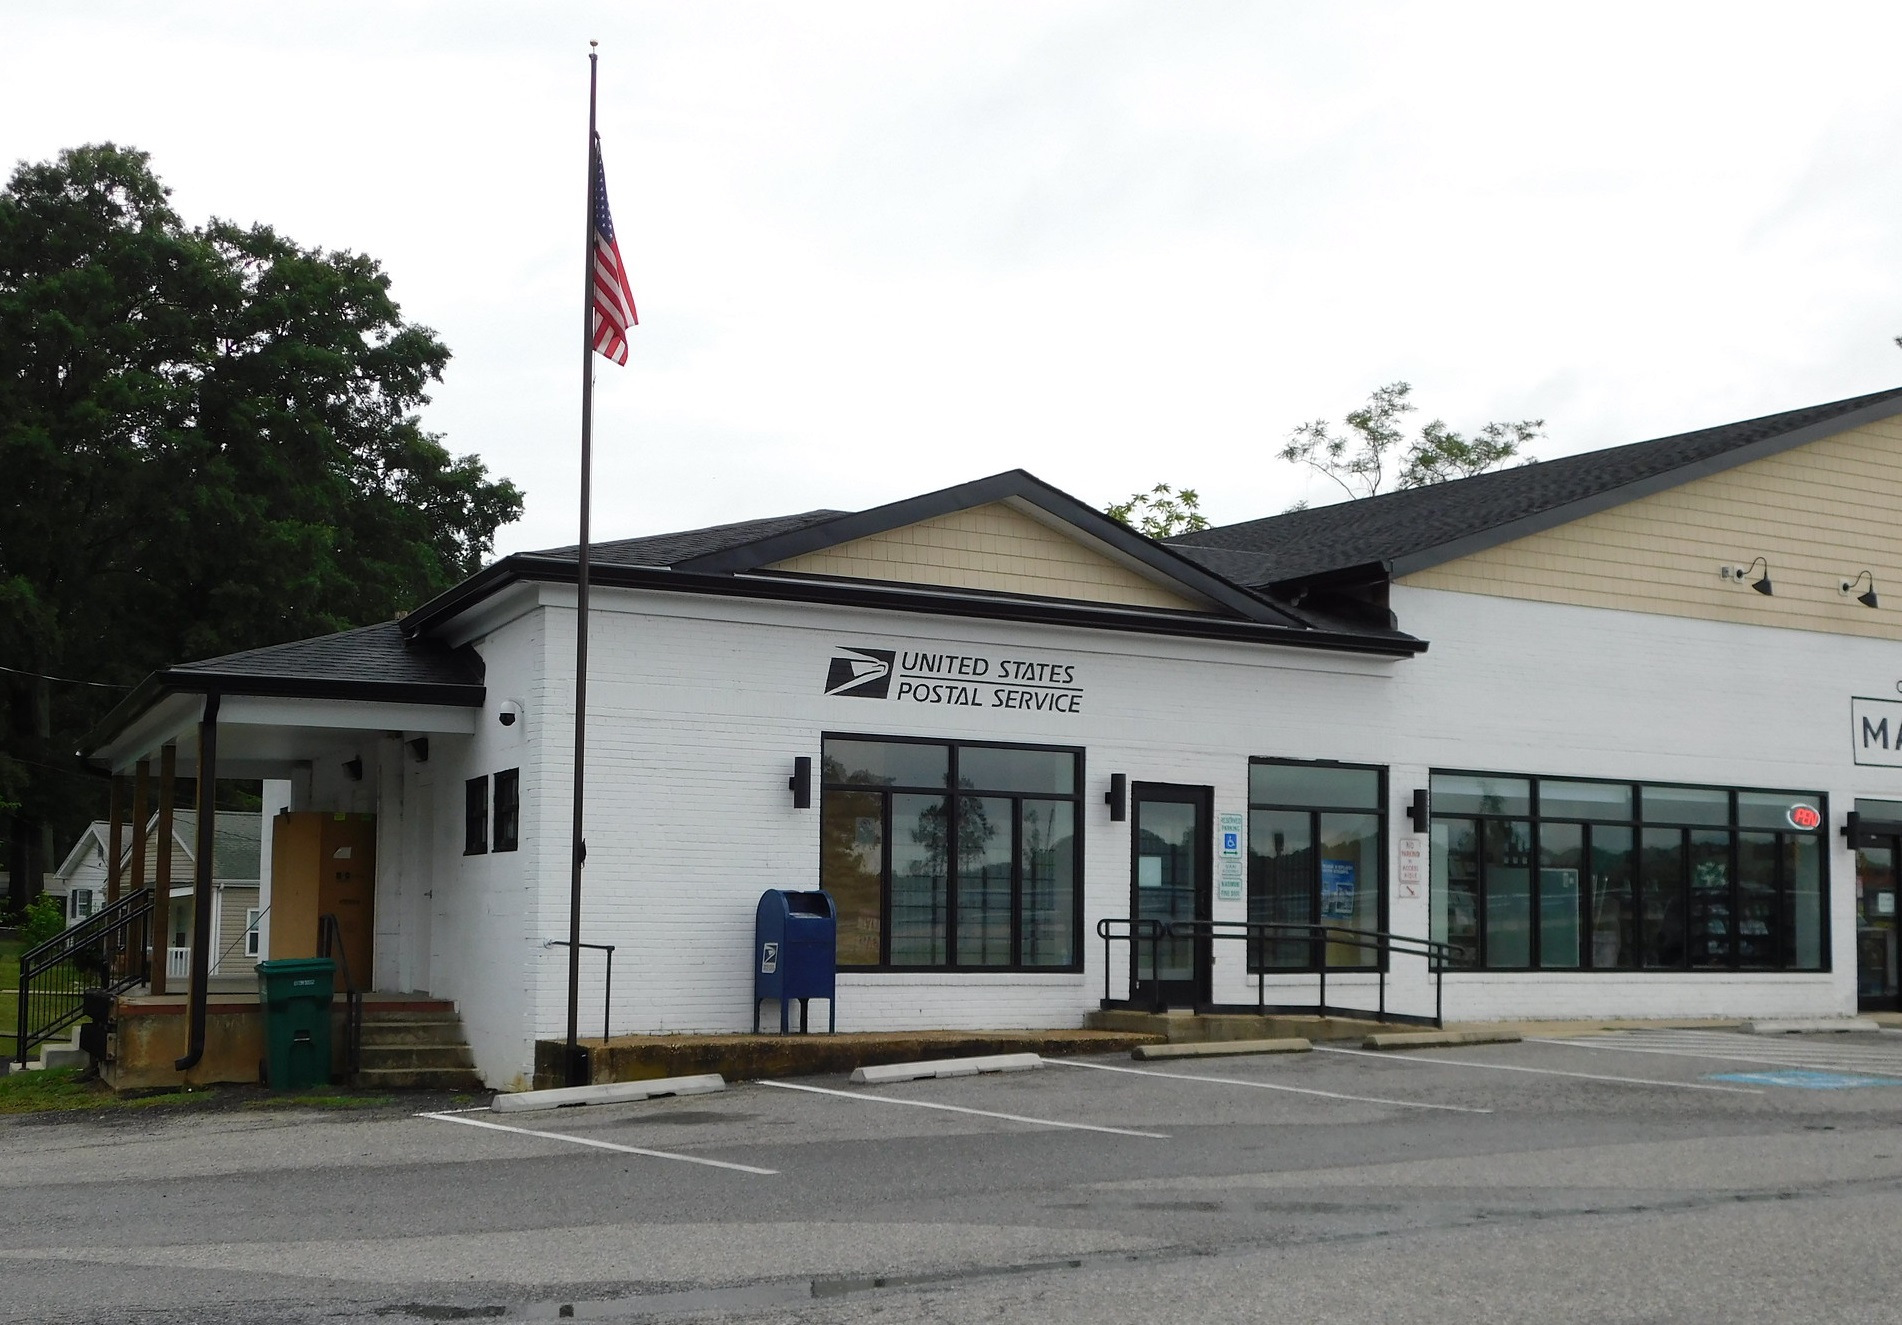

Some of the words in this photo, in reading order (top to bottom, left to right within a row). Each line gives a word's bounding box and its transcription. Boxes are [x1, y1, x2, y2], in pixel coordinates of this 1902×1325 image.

[901, 652, 989, 676] UNITED
[998, 660, 1075, 684] STATES
[897, 682, 983, 706] POSTAL
[991, 689, 1083, 713] SERVICE
[1863, 716, 1902, 751] M
[1792, 807, 1818, 827] PEN
